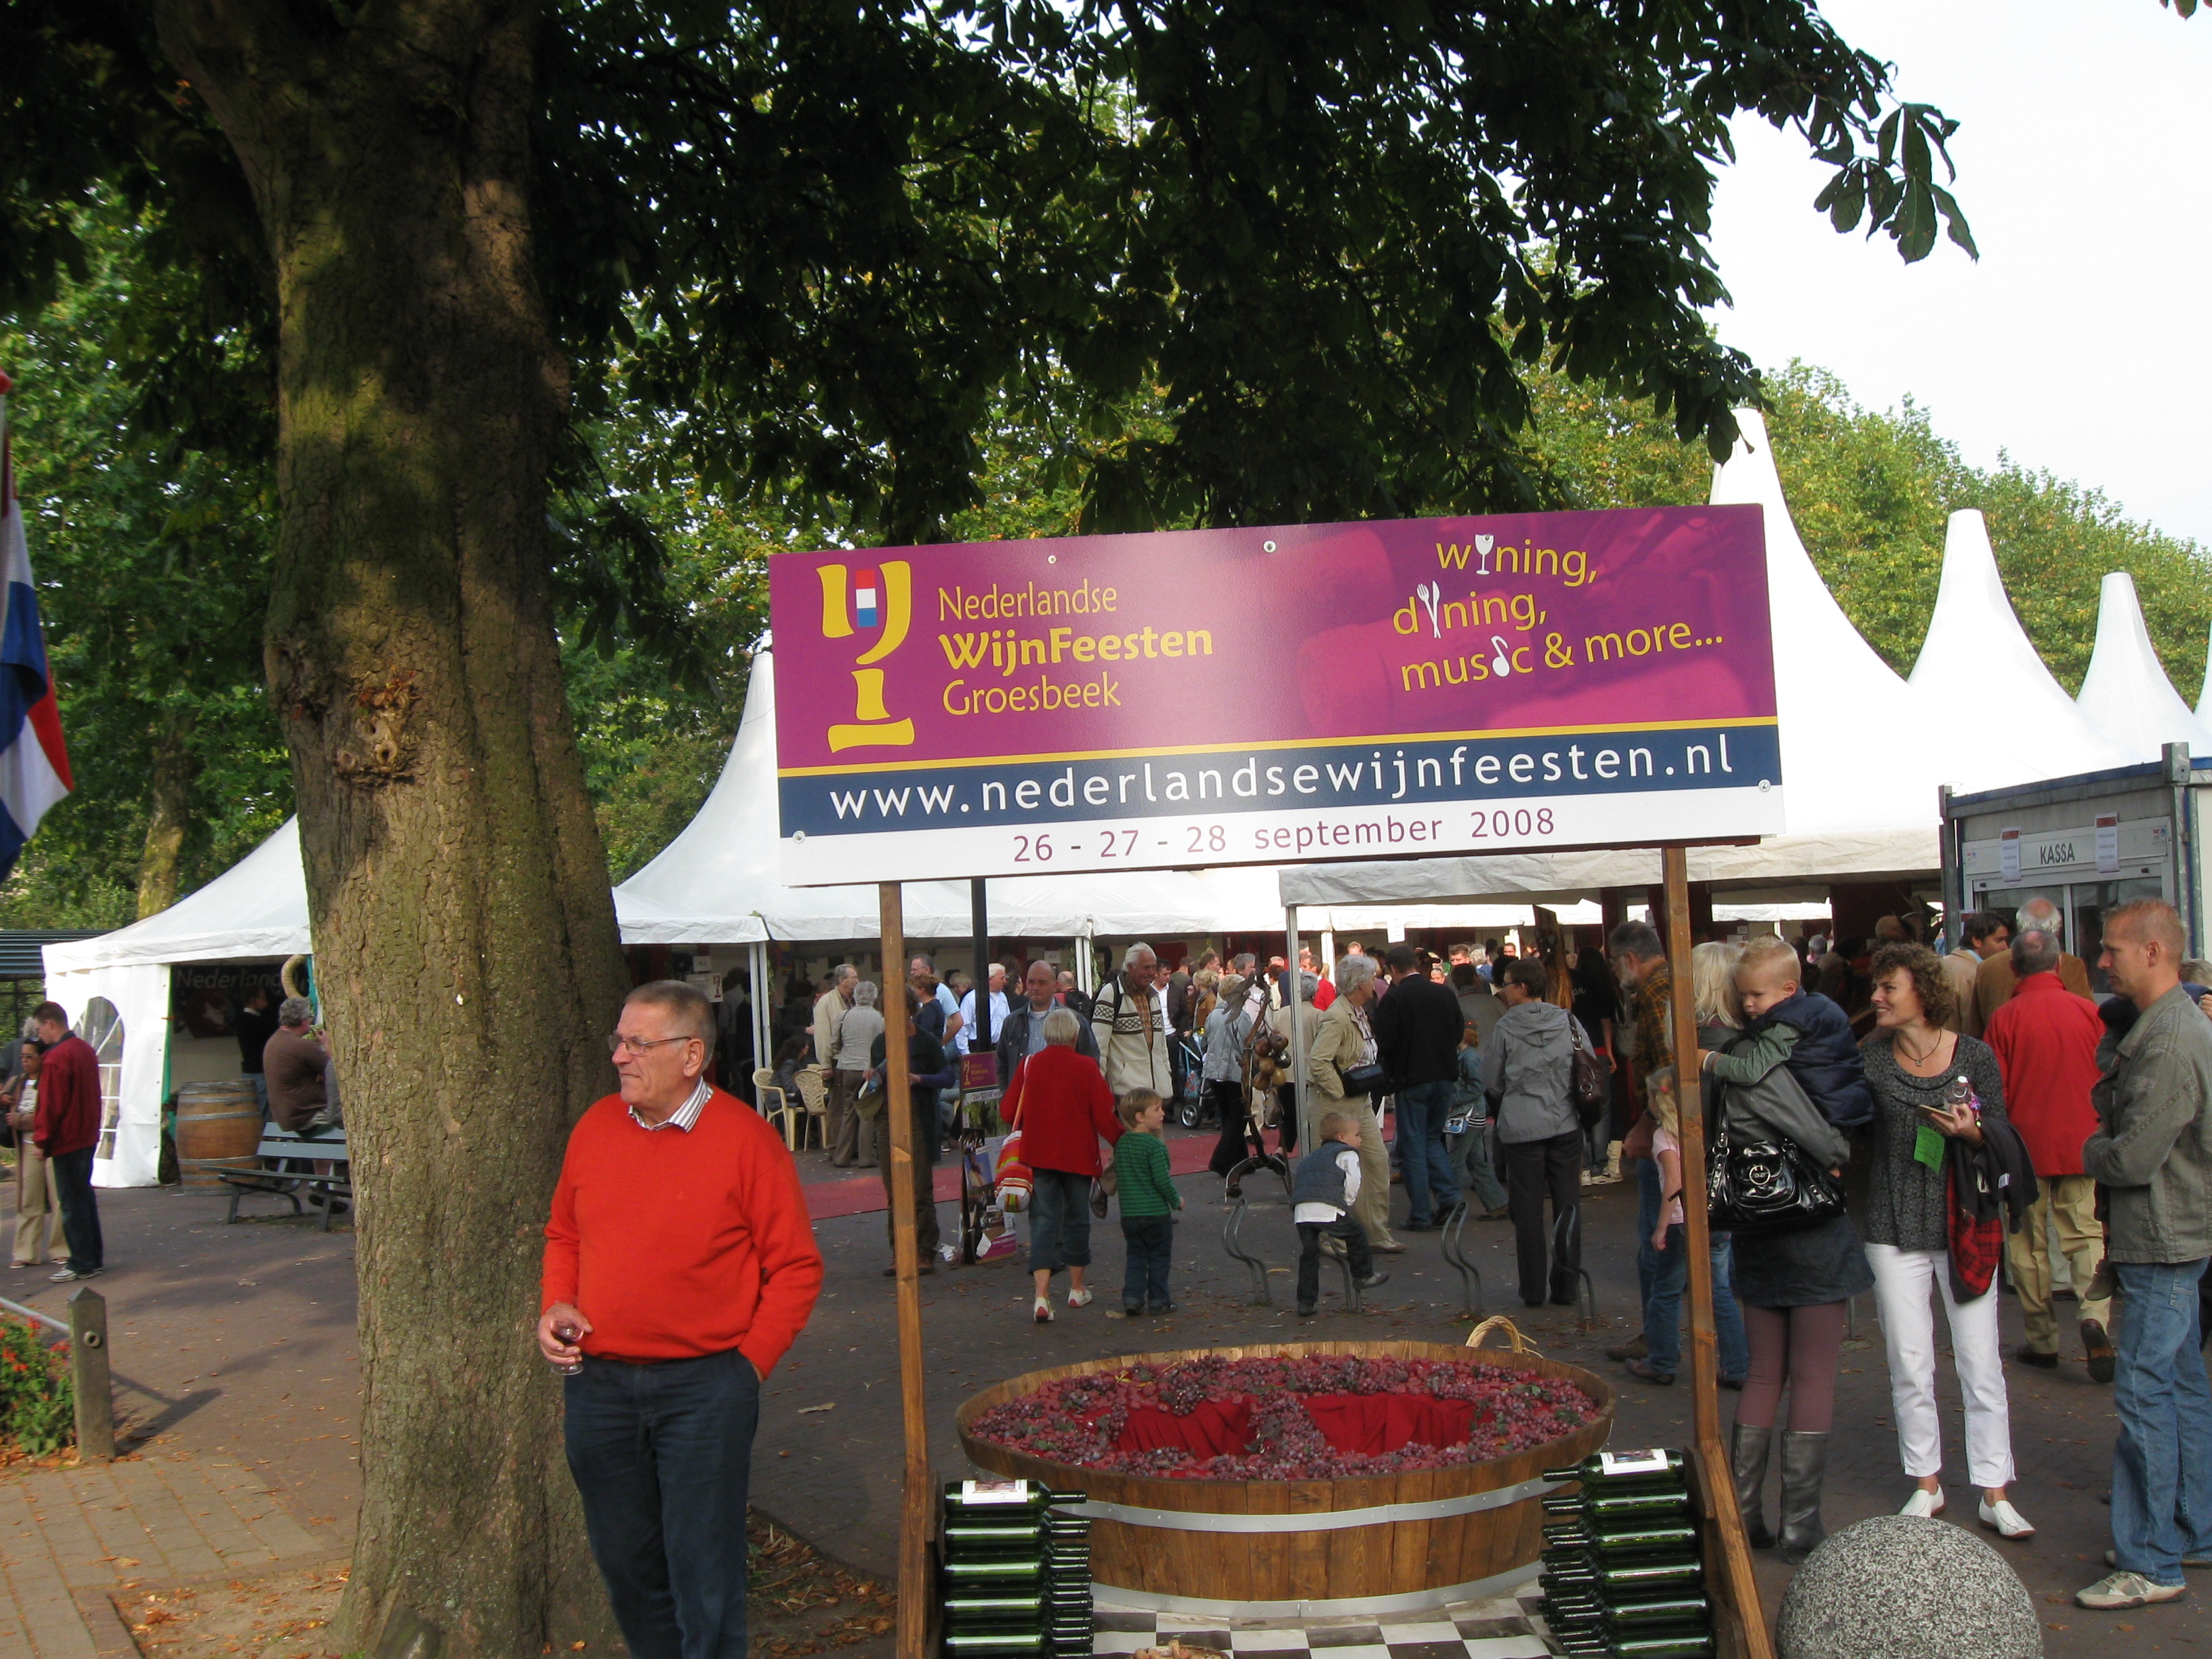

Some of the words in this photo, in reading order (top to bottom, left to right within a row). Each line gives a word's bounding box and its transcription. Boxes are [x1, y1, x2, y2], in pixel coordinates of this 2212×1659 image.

[937, 578, 1118, 621] Nederlandse
[937, 626, 1214, 677] WijnFeesten
[1544, 632, 1576, 669] &
[1584, 622, 1724, 662] more...
[943, 672, 1122, 716] Groesbeek
[830, 733, 1733, 819] www.nederlandsewijnfeesten.nl
[1013, 834, 1053, 862] 26
[1100, 830, 1139, 858] 27
[1187, 825, 1226, 853] 28
[1254, 814, 1443, 854] september
[1471, 807, 1555, 838] 2008
[2040, 843, 2075, 865] KASSA
